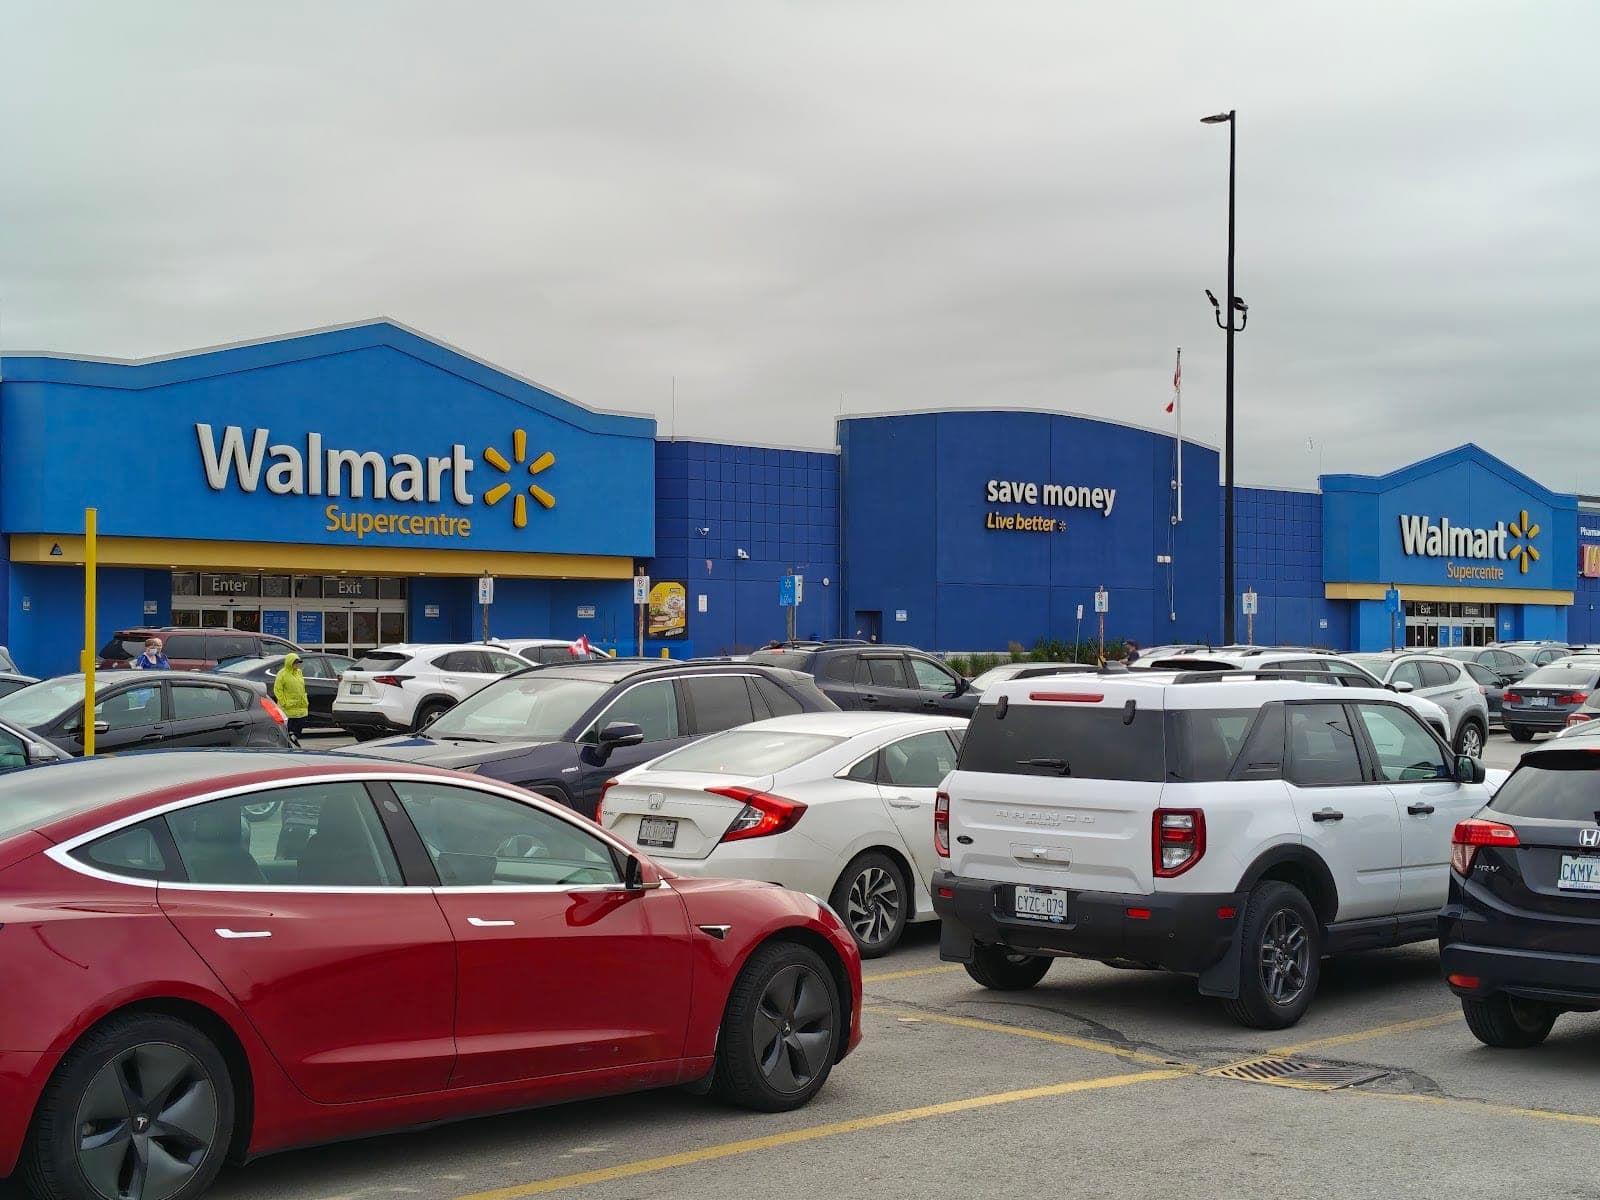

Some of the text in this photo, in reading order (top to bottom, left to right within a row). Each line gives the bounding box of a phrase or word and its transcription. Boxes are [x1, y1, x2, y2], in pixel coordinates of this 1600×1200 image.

[195, 423, 474, 505] Walmart
[987, 479, 1116, 517] save money
[325, 504, 471, 539] Supercentre
[987, 511, 1056, 532] Live better
[1400, 514, 1508, 560] Walmart
[1447, 561, 1504, 582] Supercentre
[212, 576, 248, 592] Enter
[338, 581, 362, 594] Exit
[1420, 603, 1431, 615] Exit
[1561, 863, 1593, 882] CKMV
[1017, 896, 1064, 915] CYZC 079
